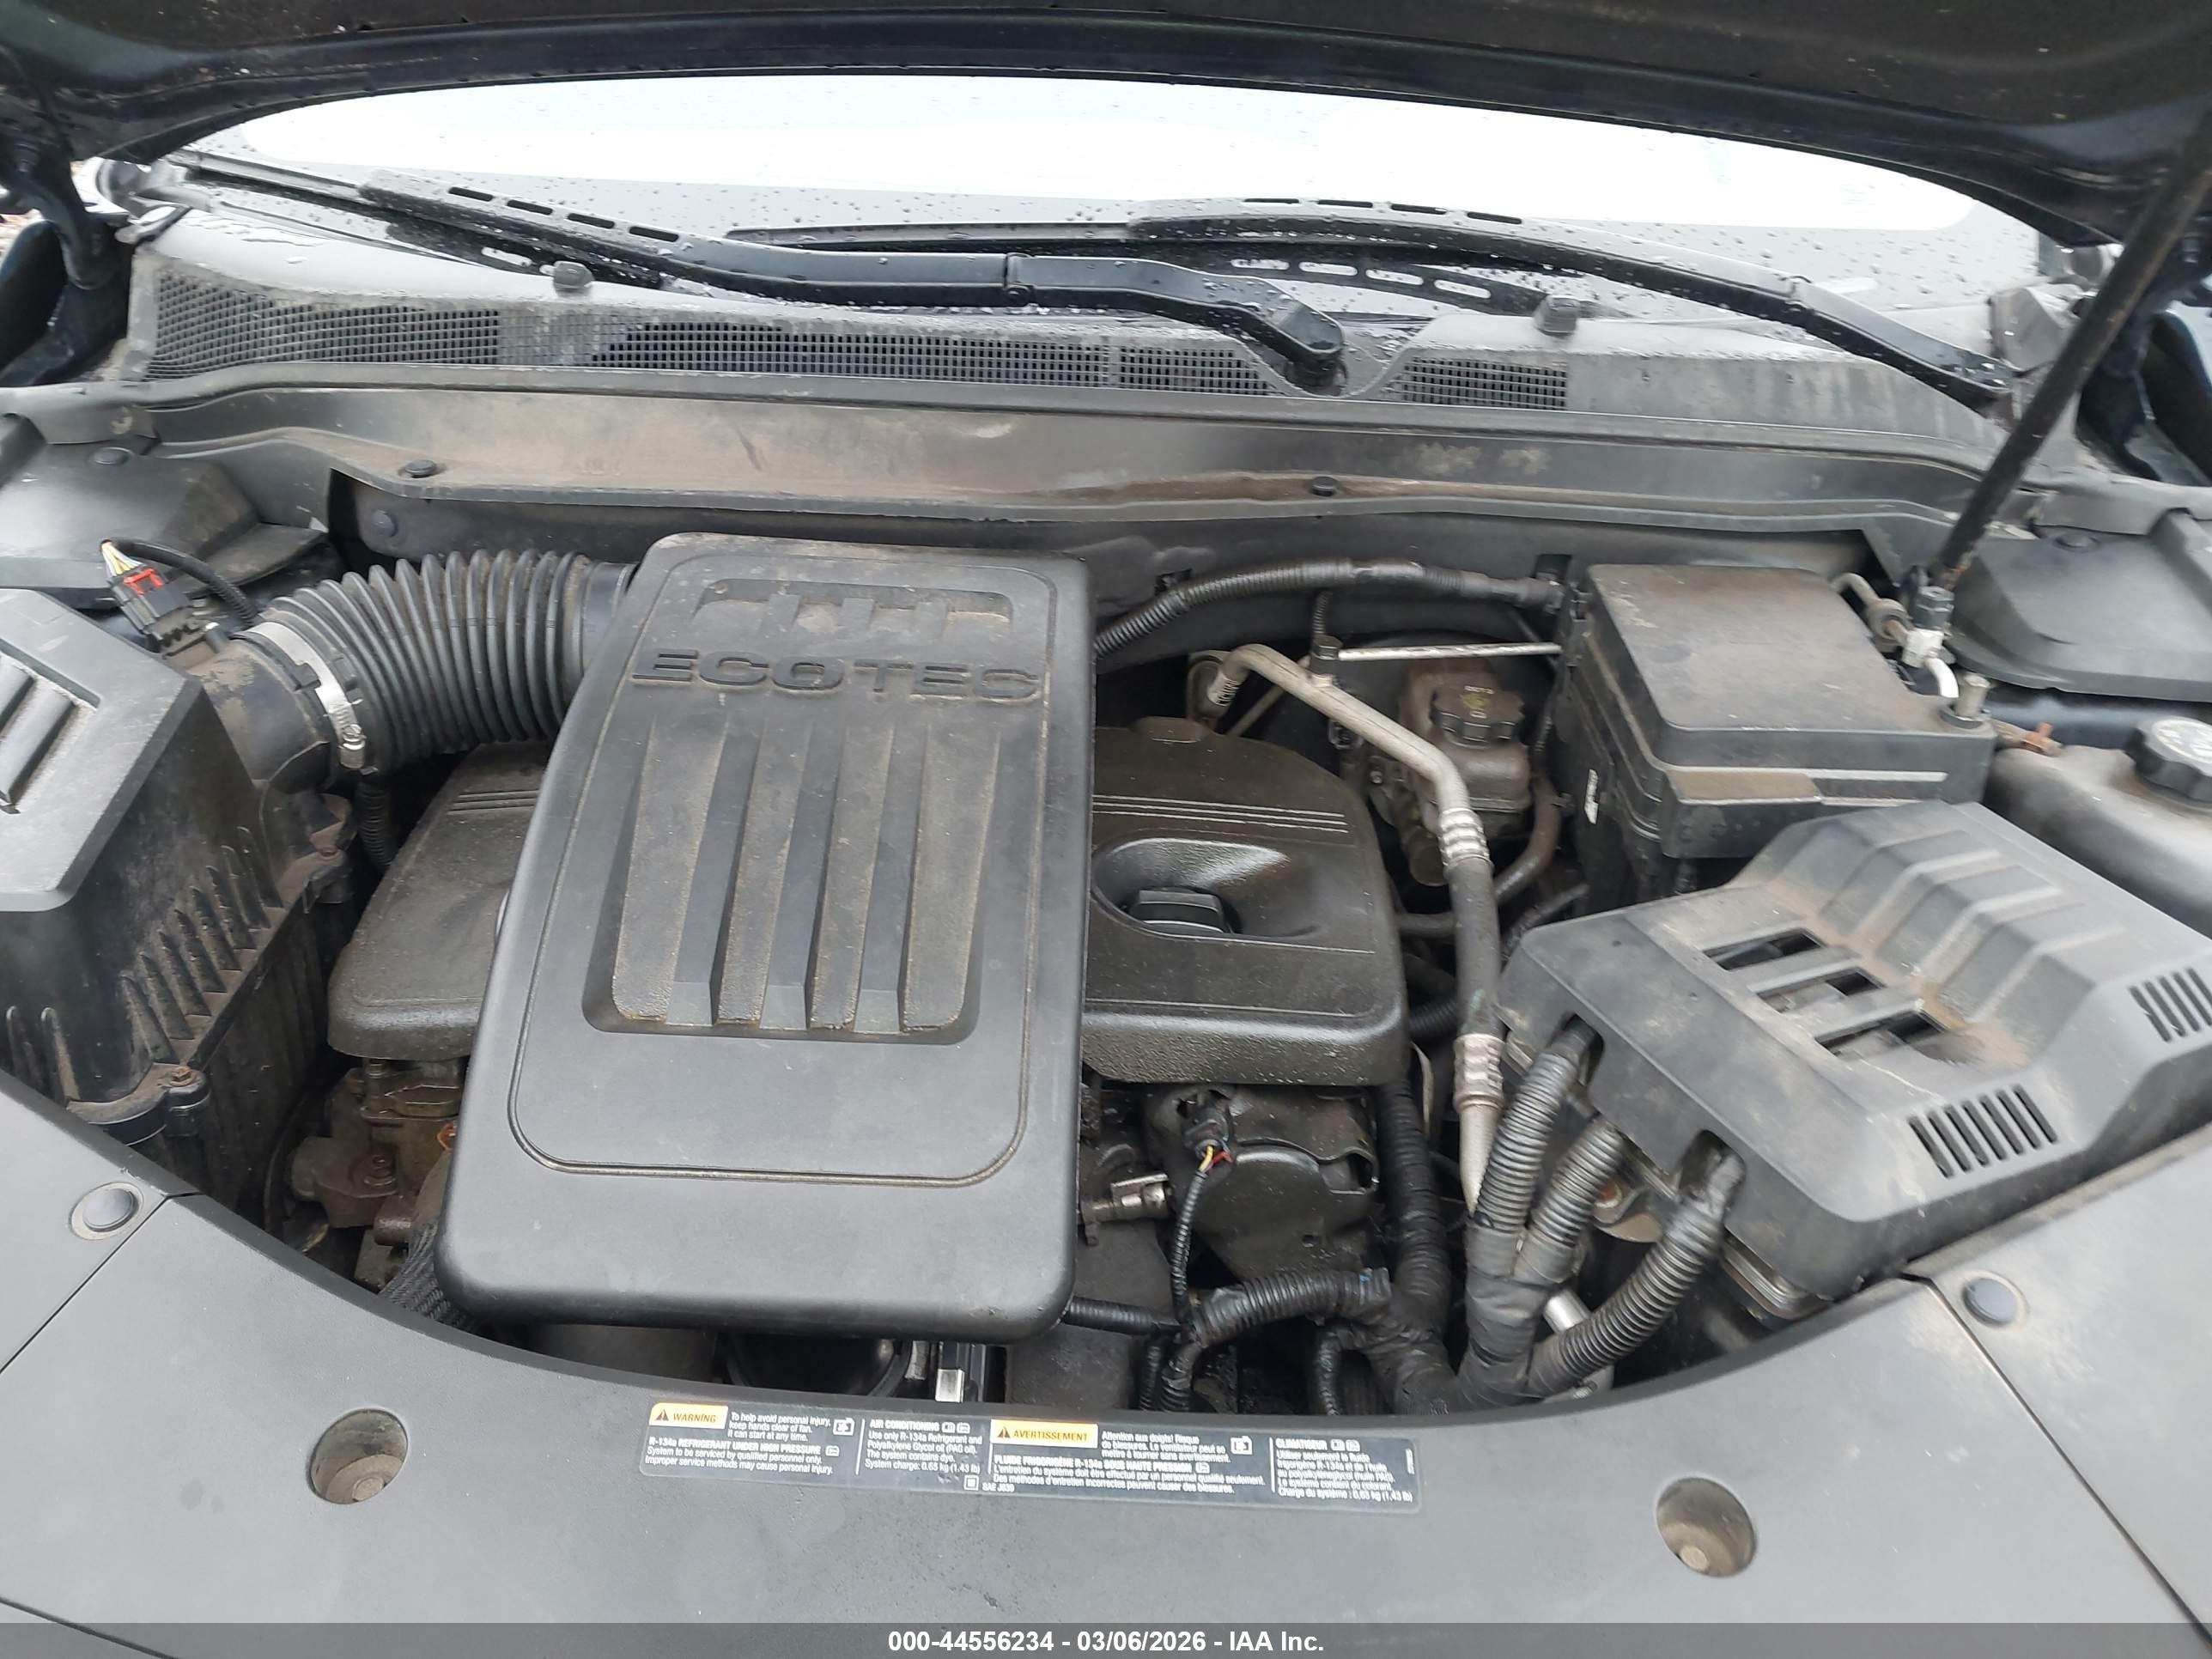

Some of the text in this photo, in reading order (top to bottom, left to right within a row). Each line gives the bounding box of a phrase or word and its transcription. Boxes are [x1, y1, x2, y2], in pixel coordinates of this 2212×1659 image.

[631, 649, 1042, 702] ECOTEC
[672, 1413, 716, 1423] WARNING
[732, 1412, 739, 1420] To
[741, 1413, 757, 1422] help
[757, 1413, 777, 1423] avoid
[778, 1414, 808, 1425] personal
[729, 1421, 812, 1433] keep hands clear of fan.
[870, 1419, 939, 1431] AIR CONDITIONING
[749, 1431, 766, 1440] start
[775, 1433, 789, 1442] any
[790, 1433, 808, 1442] time.
[868, 1430, 982, 1444] Use only R-134a Refrigerant and
[1013, 1430, 1088, 1441] AVERTISSEMENT
[1102, 1431, 1133, 1442] Attention
[1134, 1433, 1148, 1443] aux
[649, 1437, 677, 1447] R-134a
[678, 1437, 732, 1449] REFRIGERANT
[732, 1441, 758, 1451] UNDER
[912, 1443, 934, 1452] Glycol
[945, 1444, 963, 1454] (PAG
[1101, 1441, 1112, 1449] de
[1149, 1443, 1159, 1451] Le
[1199, 1444, 1215, 1455] peut
[1216, 1445, 1226, 1454] se
[647, 1446, 822, 1465] System to be serviced by qualified personnel only.
[866, 1449, 956, 1464] The system contains dye.
[1101, 1449, 1125, 1458] mettre
[645, 1455, 833, 1475] Improper service methods may cause personal injury.
[865, 1458, 891, 1469] System
[893, 1460, 921, 1471] charge:
[939, 1462, 950, 1474] kg
[970, 1463, 981, 1474] lb)
[1126, 1461, 1152, 1471] HAUTE
[1032, 1466, 1042, 1475] du
[1075, 1468, 1089, 1478] doit
[1136, 1472, 1149, 1481] par
[1150, 1473, 1160, 1481] un
[982, 1482, 996, 1492] SAE
[993, 1474, 1007, 1483] Des
[1182, 1482, 1196, 1492] des
